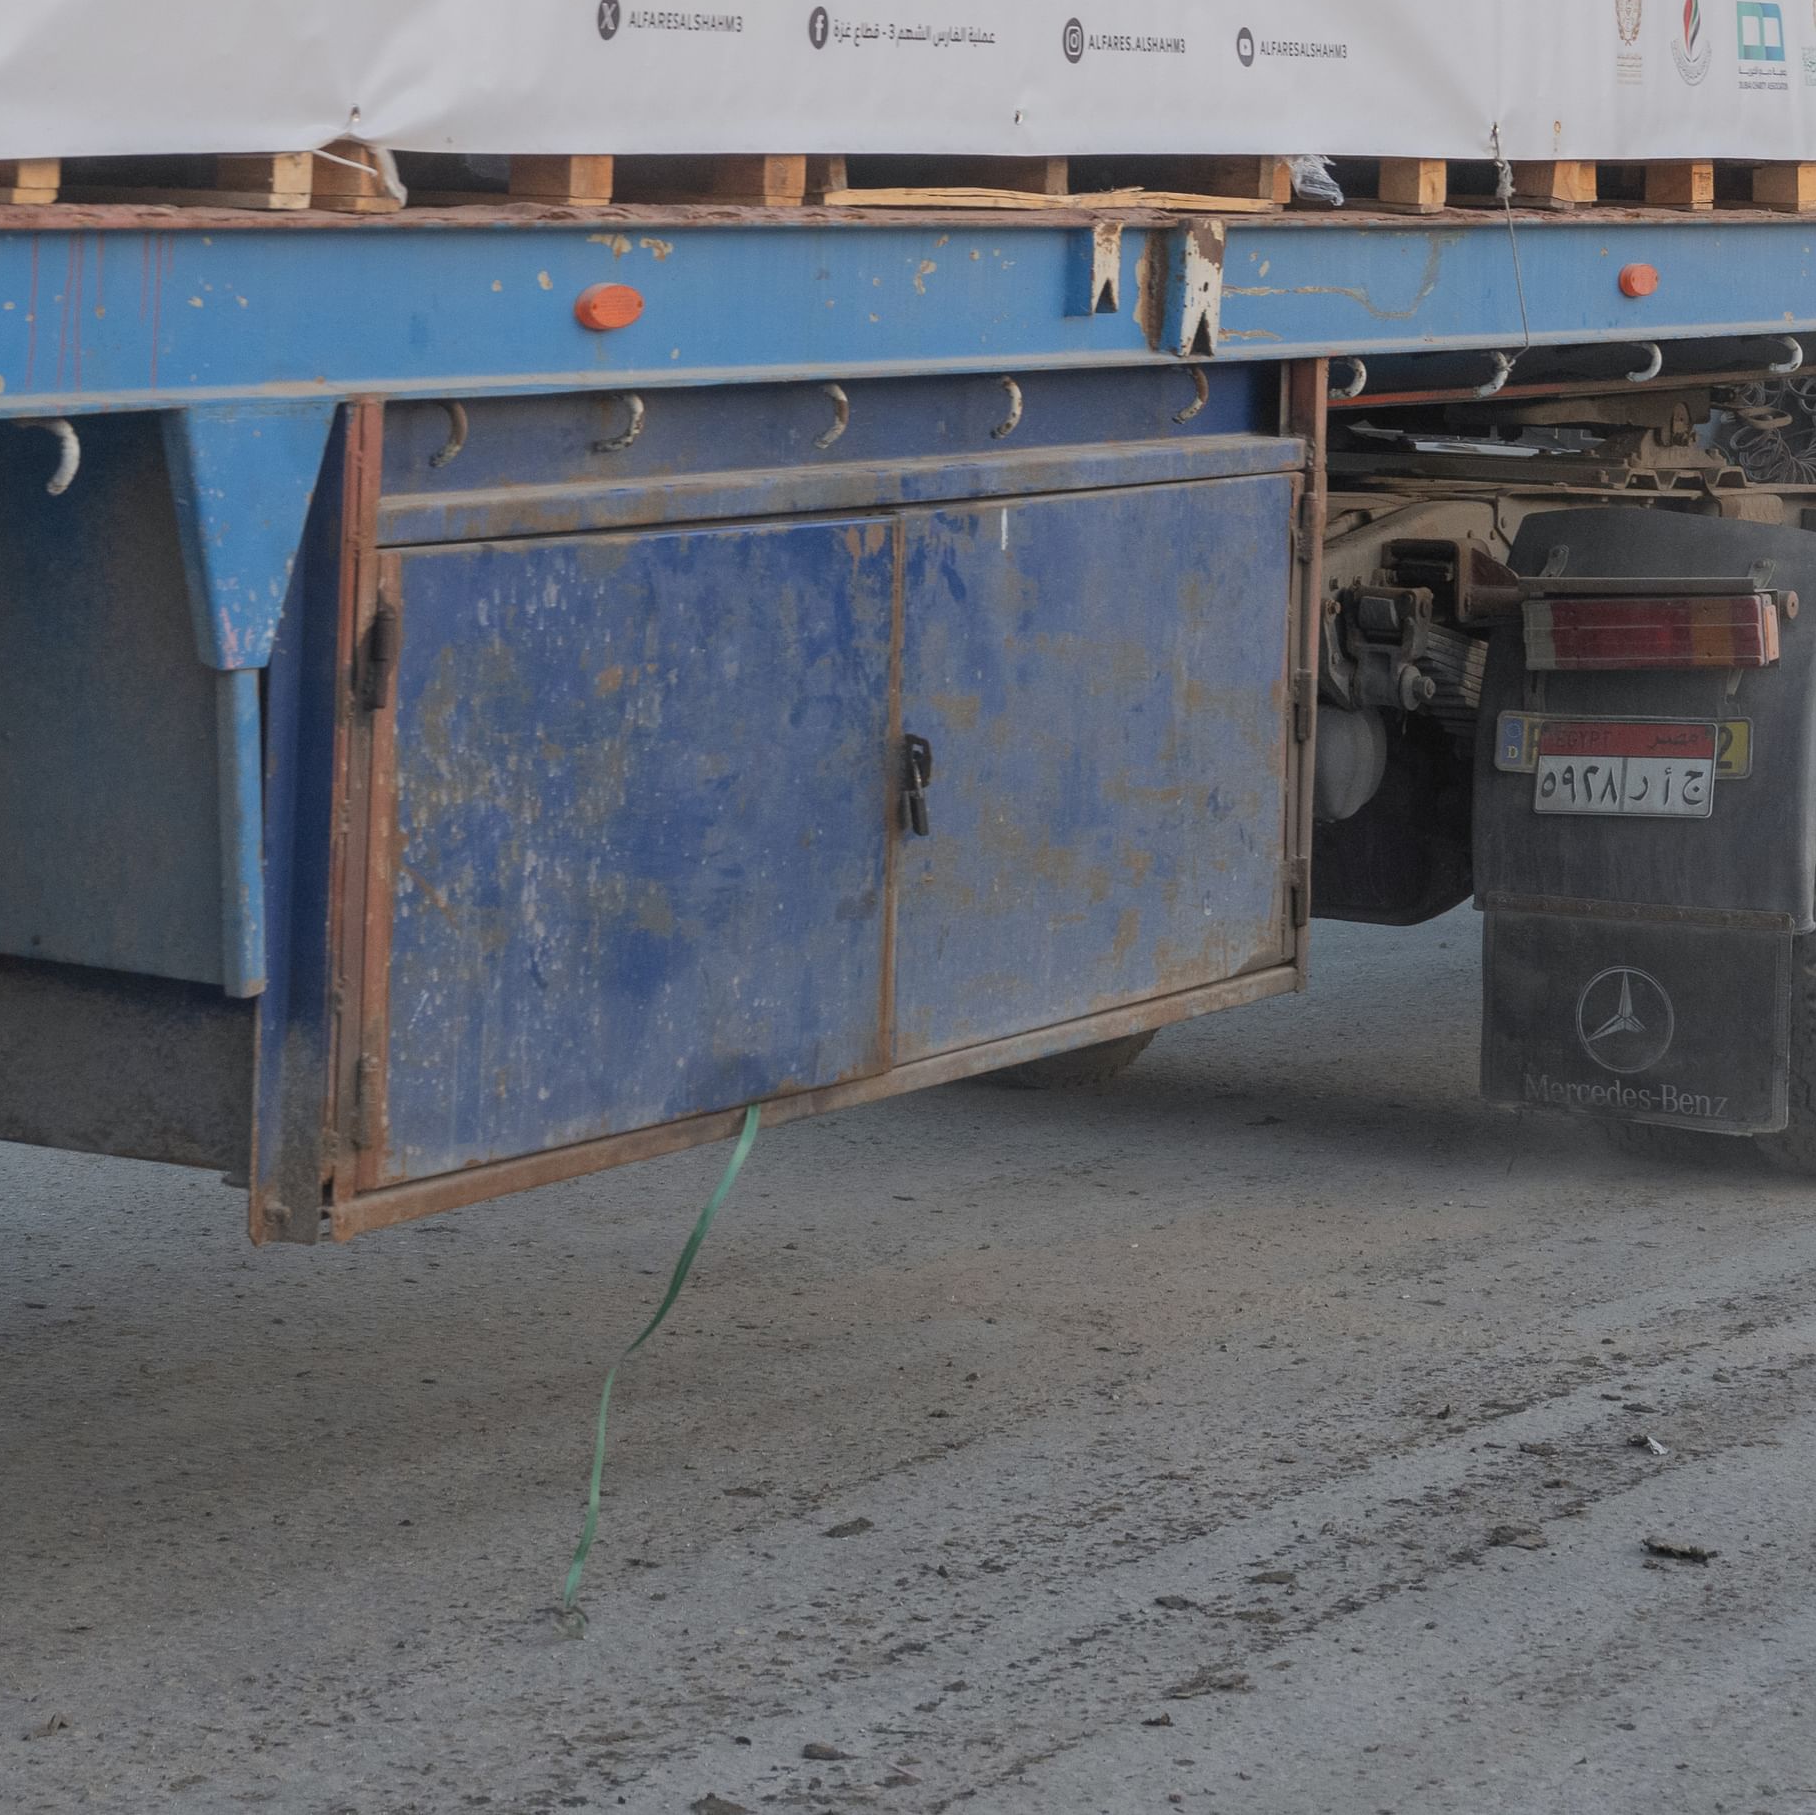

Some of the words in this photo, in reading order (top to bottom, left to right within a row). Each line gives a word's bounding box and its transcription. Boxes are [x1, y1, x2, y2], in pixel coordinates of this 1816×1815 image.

[627, 10, 743, 33] ALFARESALSHAHM3
[1087, 34, 1185, 54] ALFARES.ALSHAHM3
[1259, 41, 1348, 59] ALFARESALSHAHM3
[1554, 732, 1612, 749] EGYPT
[1648, 732, 1699, 751] مصر
[1507, 744, 1519, 759] D
[1522, 1072, 1729, 1118] Mercedes-Benz
